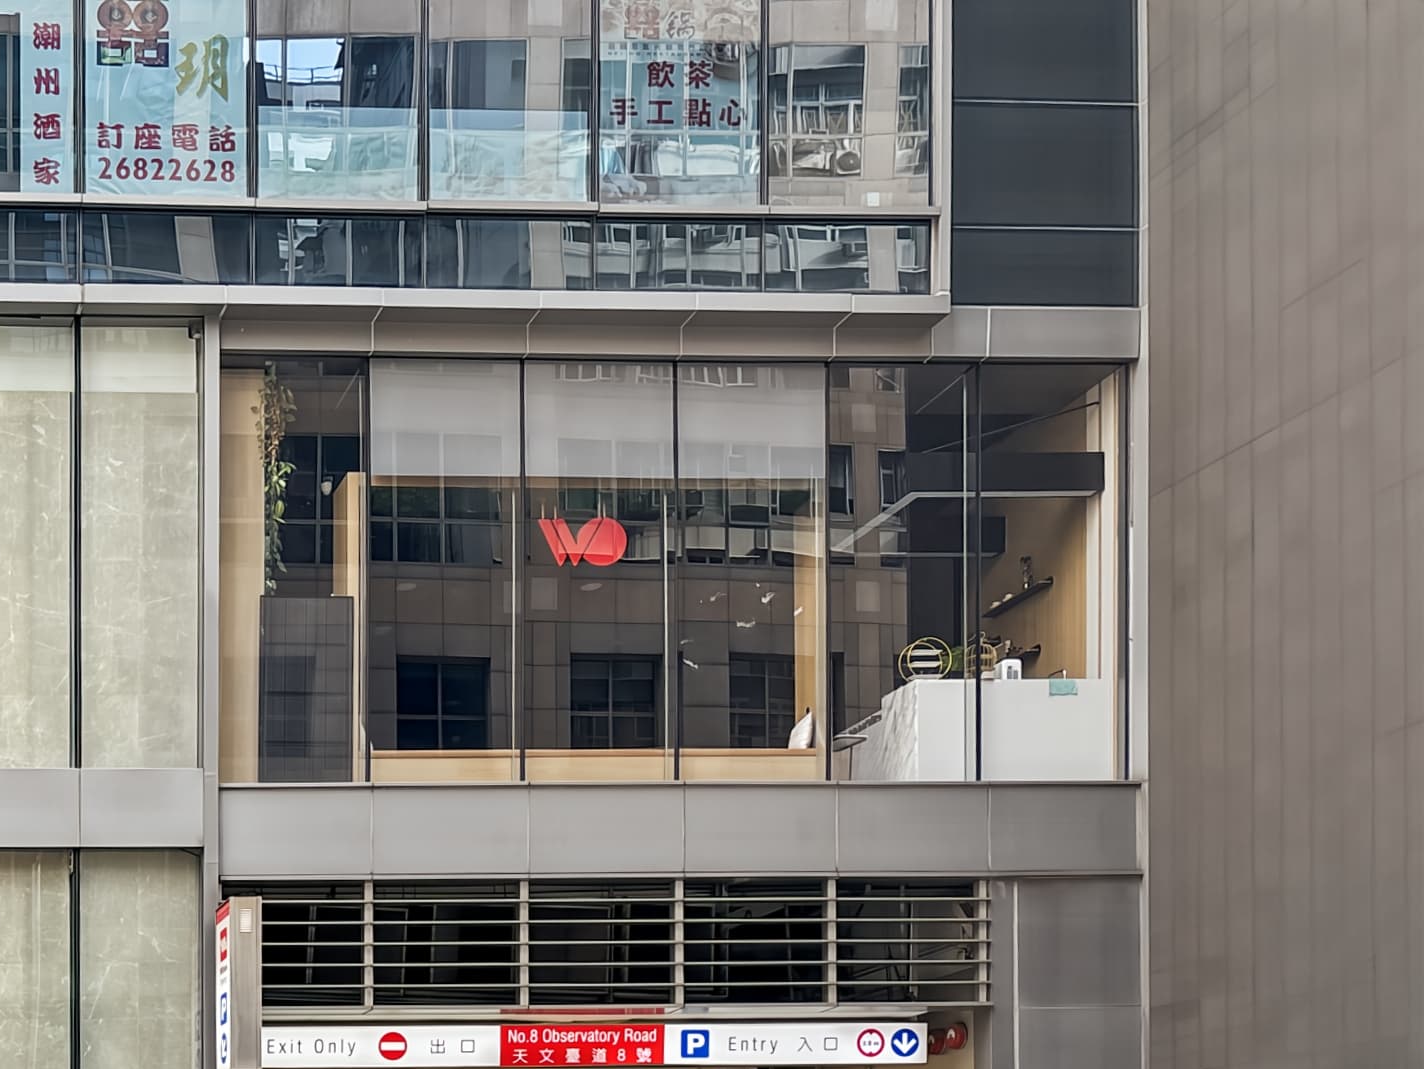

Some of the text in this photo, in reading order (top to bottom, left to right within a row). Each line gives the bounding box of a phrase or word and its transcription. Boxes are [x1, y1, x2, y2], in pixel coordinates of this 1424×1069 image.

[646, 60, 714, 90] 飲茶
[32, 21, 63, 186] 潮州酒家
[608, 97, 748, 128] 手工點心
[96, 122, 237, 153] 訂座電話
[97, 156, 236, 183] 26822628
[266, 1037, 357, 1057] Exit Only
[429, 1037, 476, 1055] 出口
[508, 1027, 657, 1046] No.8 Observatory Road
[728, 1036, 778, 1055] Entry
[797, 1036, 839, 1053] 入口
